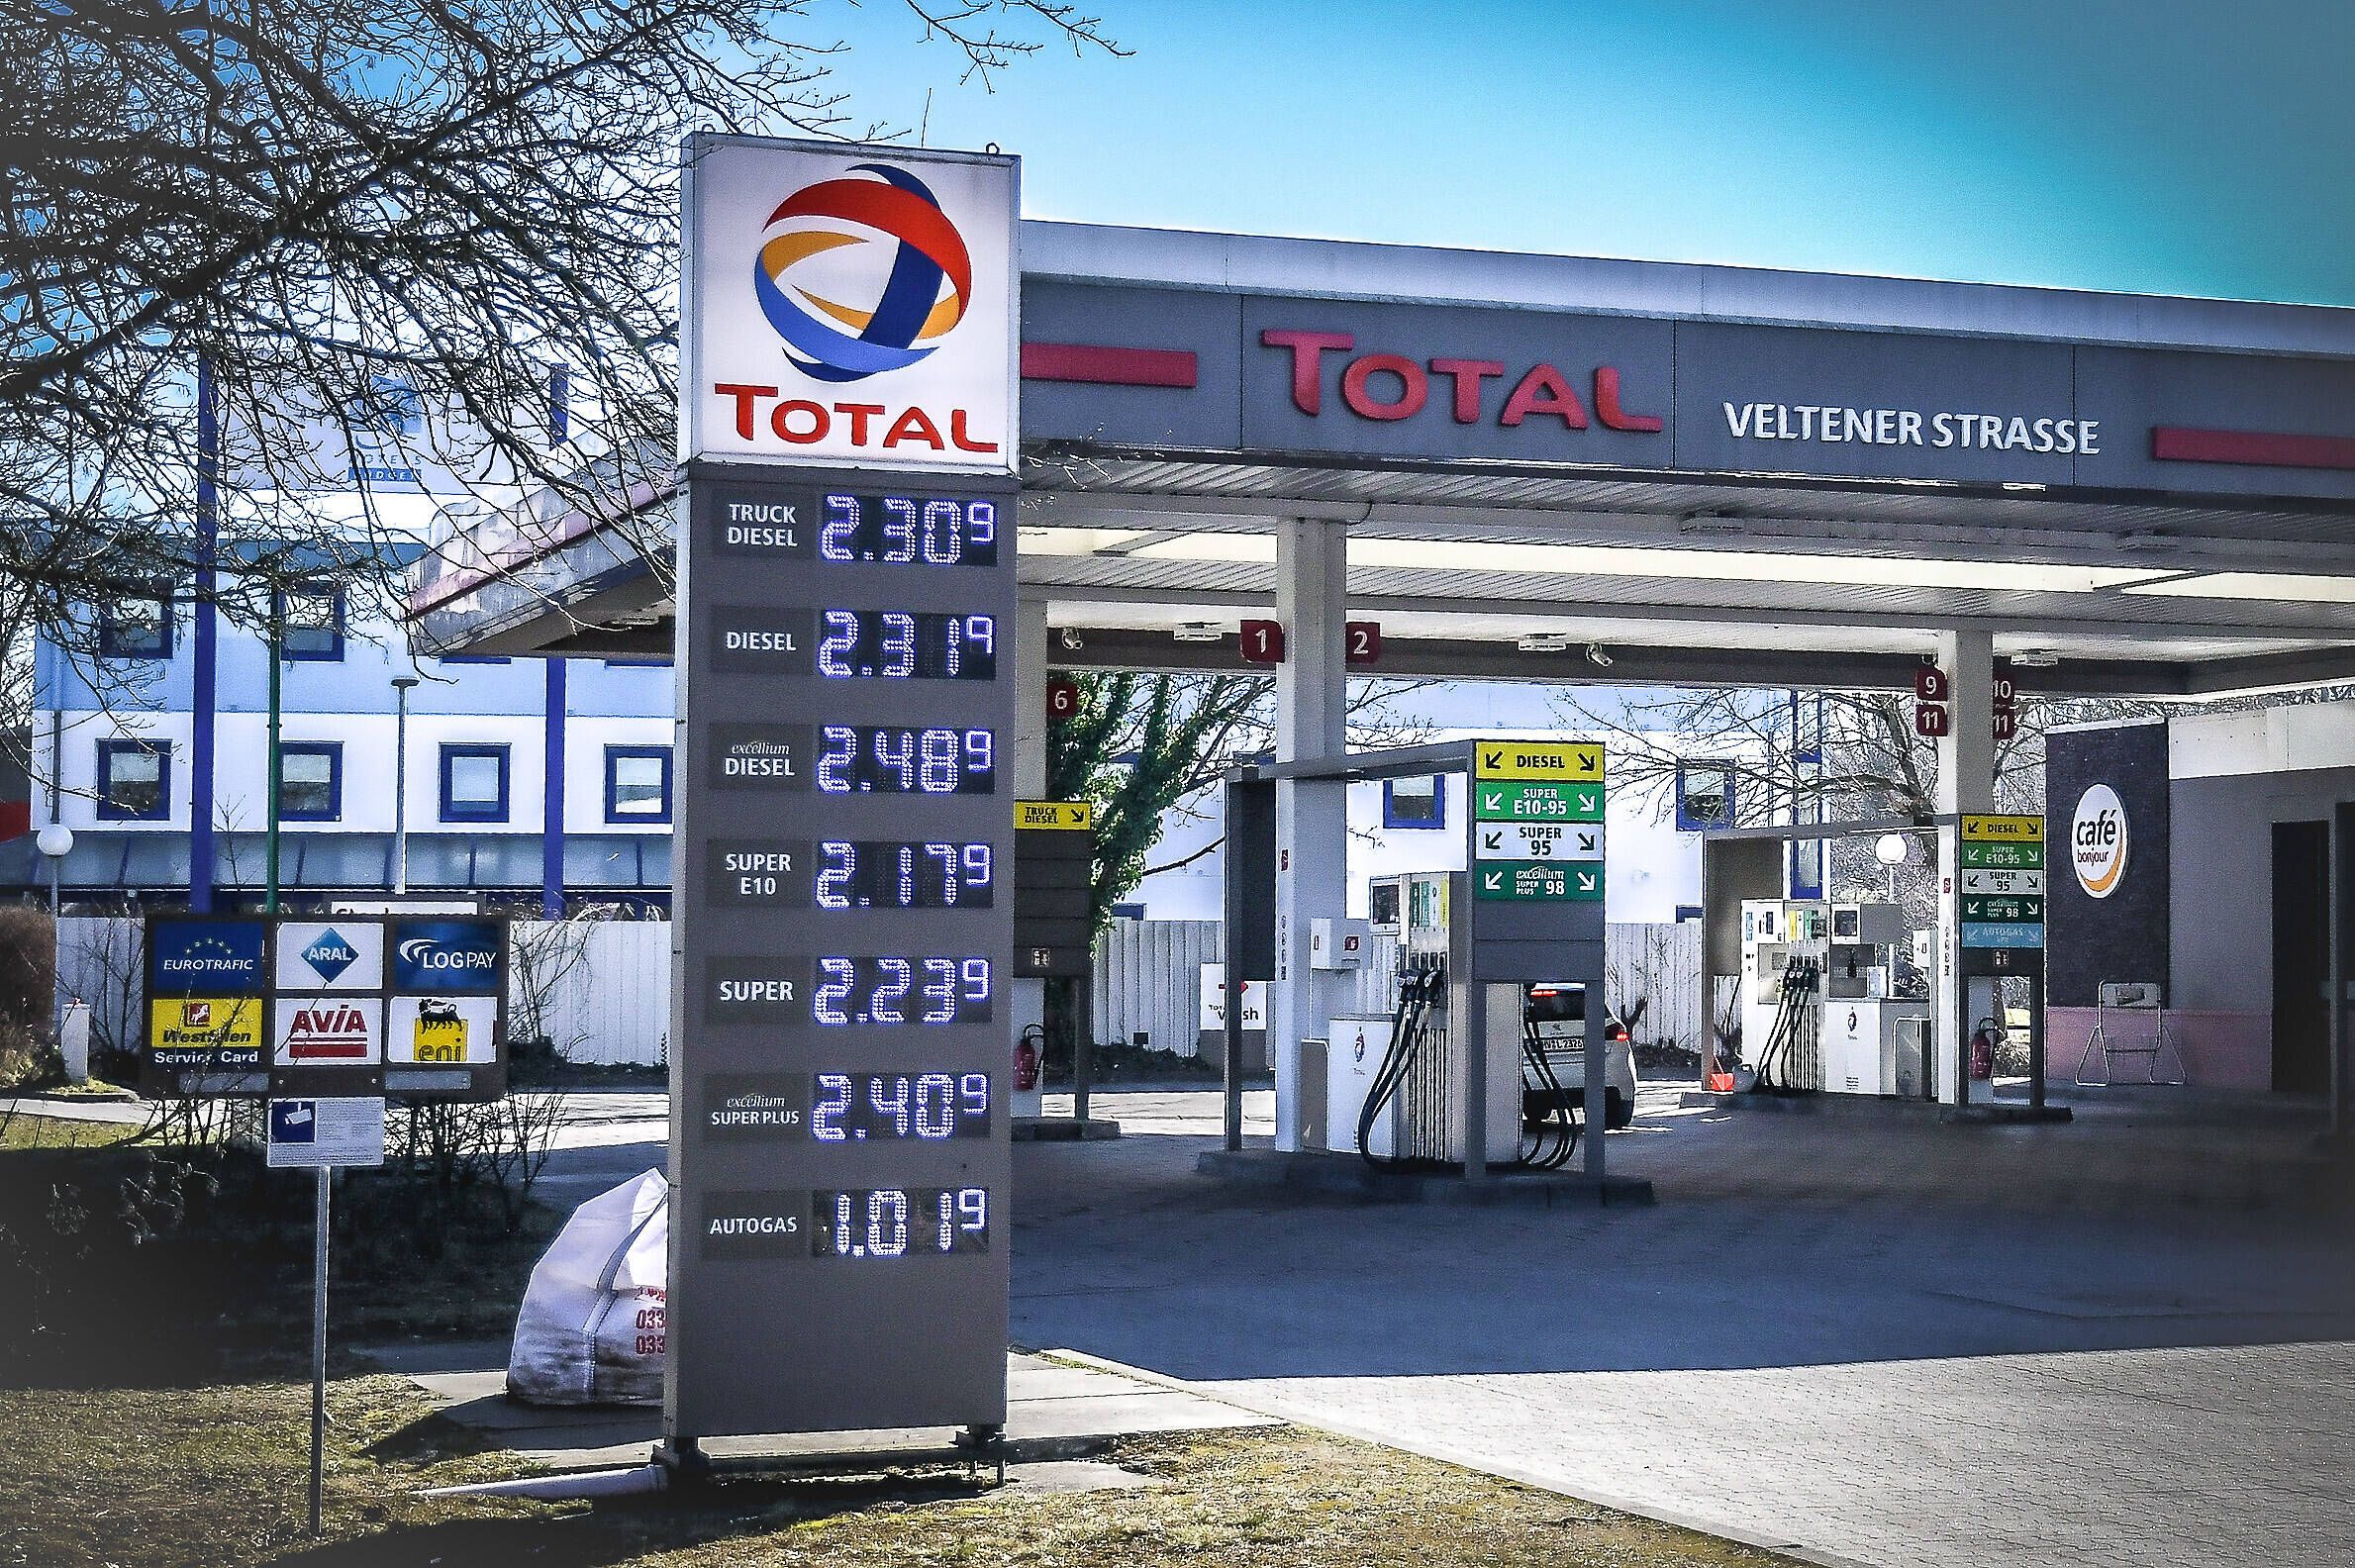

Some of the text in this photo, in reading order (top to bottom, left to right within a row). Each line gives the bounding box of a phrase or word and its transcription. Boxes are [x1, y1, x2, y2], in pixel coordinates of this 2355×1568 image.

[1261, 329, 1663, 433] TOTAL
[715, 383, 999, 453] TOTAL
[1723, 401, 2101, 454] VELTENER STRASSE
[729, 503, 797, 524] TRUCK
[728, 528, 798, 547] DIESEL
[726, 631, 797, 651] DIESEL
[1255, 629, 1267, 653] 1
[1353, 631, 1369, 654] 2
[1925, 676, 1937, 694] 9
[1992, 680, 2012, 698] 10
[1054, 690, 1068, 710] 6
[1922, 711, 1938, 729] 11
[1993, 715, 2009, 733] 11
[732, 741, 791, 755] excellium
[724, 757, 795, 776] DIESEL
[1516, 755, 1565, 768] DIESEL
[1522, 788, 1558, 799] SUPER
[1025, 806, 1058, 815] TRUCK
[1514, 800, 1567, 815] E10-95
[1025, 815, 1058, 824] DIESEL
[2077, 810, 2116, 845] café
[1519, 828, 1562, 838] SUPER
[1987, 824, 2019, 833] DIESEL
[1530, 840, 1551, 856] 95
[725, 853, 792, 872] SUPER
[1986, 853, 2019, 864] E10-95
[2077, 848, 2109, 866] bonjour
[1516, 865, 1565, 880] excellium
[739, 877, 777, 896] E10
[1545, 881, 1565, 895] 98
[1997, 881, 2011, 891] 95
[2006, 908, 2019, 918] 98
[308, 946, 352, 961] ARAL
[163, 958, 253, 971] EUROTRAFIC
[720, 981, 794, 1001] SUPER
[291, 1005, 367, 1033] AVIA
[1218, 1006, 1259, 1021] Wsh
[221, 1050, 258, 1063] Card
[419, 1037, 462, 1062] eni
[727, 1093, 785, 1108] excellium
[711, 1110, 800, 1126] SUPER PLUS
[709, 1217, 798, 1234] AUTOGAS
